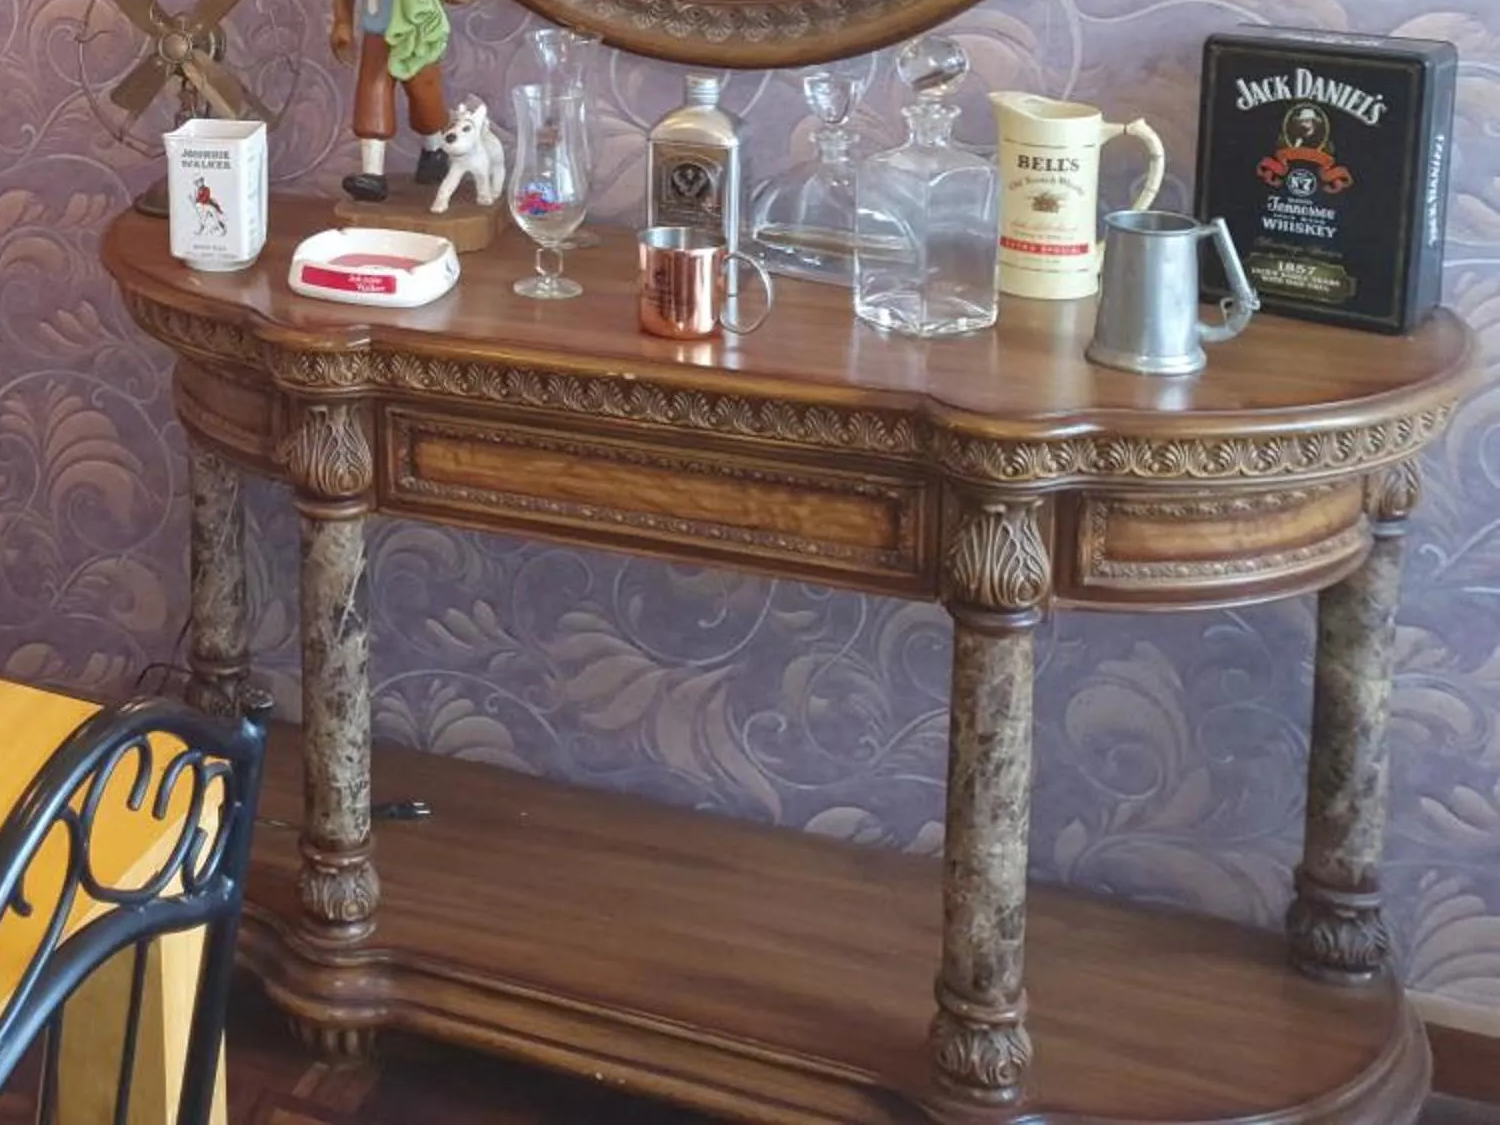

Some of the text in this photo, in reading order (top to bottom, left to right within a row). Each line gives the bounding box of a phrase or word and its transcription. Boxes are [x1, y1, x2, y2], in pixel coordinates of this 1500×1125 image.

[1235, 75, 1293, 111] JACK
[1017, 154, 1080, 172] BELL'S
[1262, 216, 1338, 238] WHISKEY
